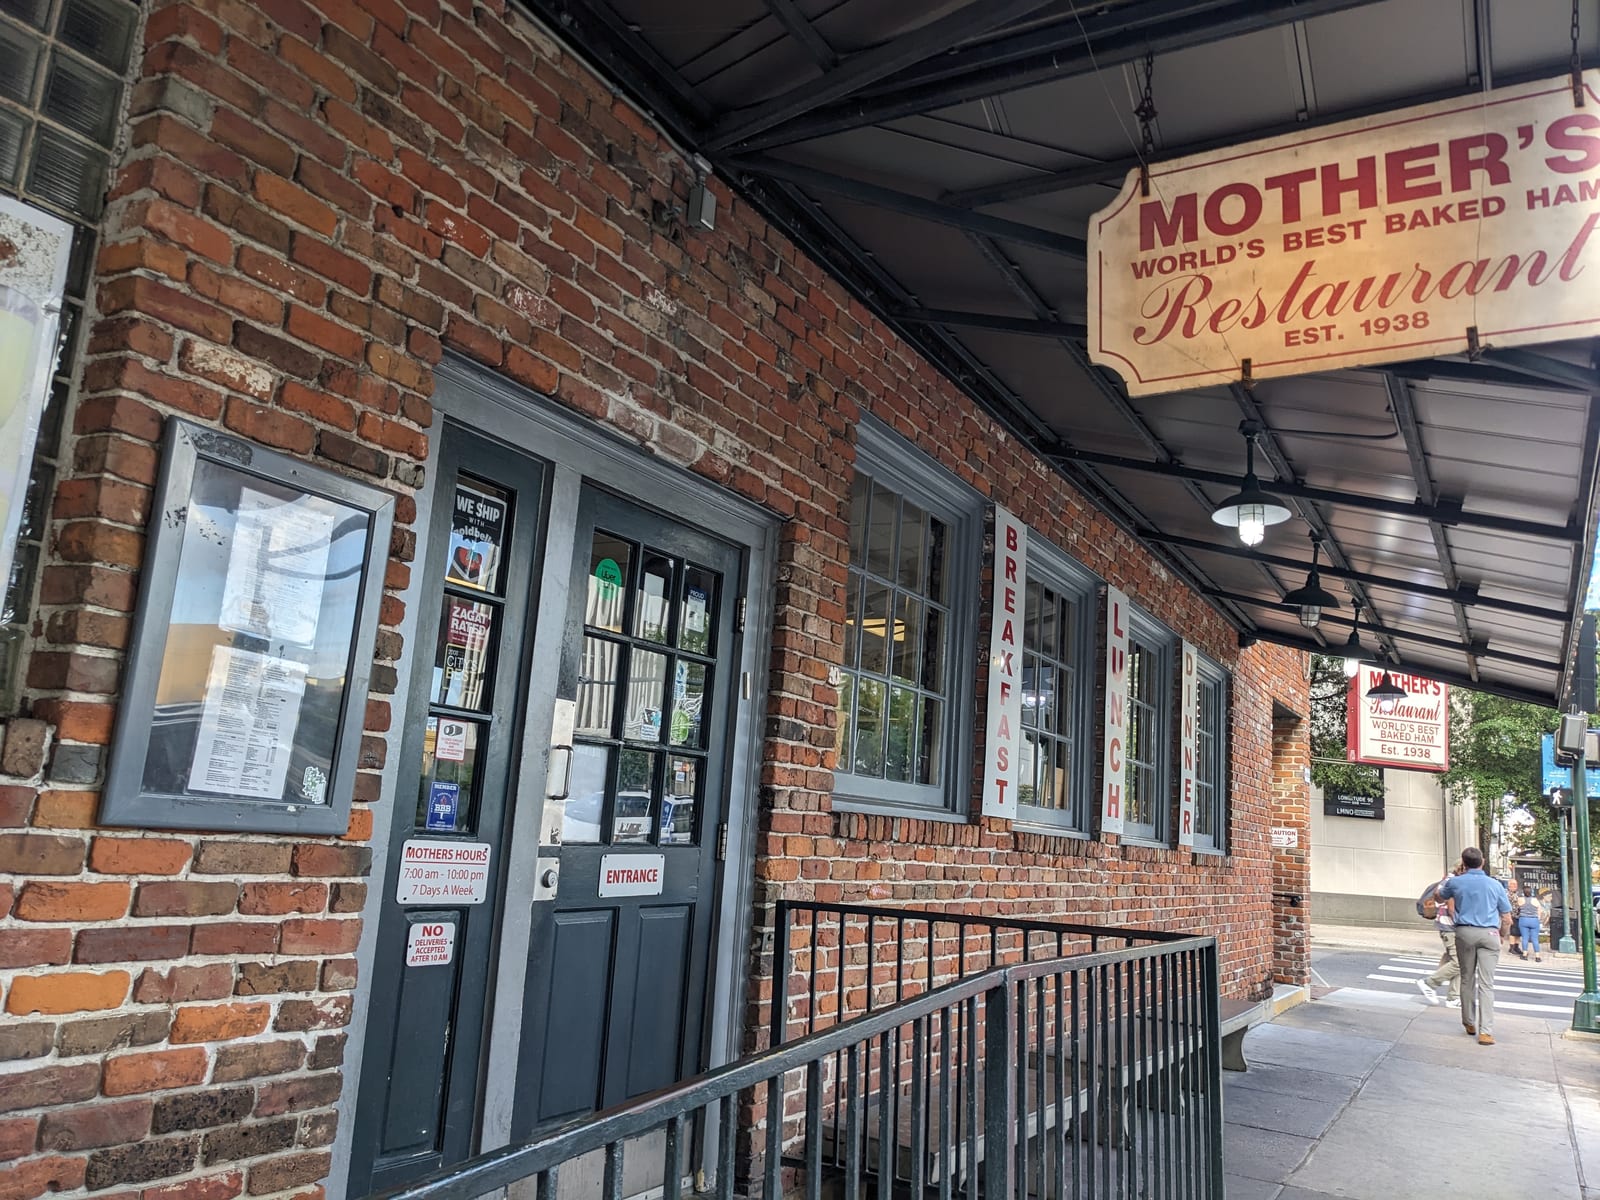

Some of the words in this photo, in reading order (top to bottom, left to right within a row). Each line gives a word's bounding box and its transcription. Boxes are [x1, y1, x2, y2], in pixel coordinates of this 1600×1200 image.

[1138, 113, 1600, 252] MOTHER'S
[1131, 238, 1266, 280] WORLD'S
[1282, 219, 1367, 253] BEST
[1385, 195, 1506, 235] BAKED
[1526, 178, 1600, 211] HAM
[1132, 210, 1600, 347] Restaurant
[1284, 324, 1345, 348] EST.
[1359, 311, 1431, 337] 1938
[456, 494, 475, 514] WE
[475, 502, 500, 522] SHIP
[469, 516, 485, 527] WITH
[452, 605, 489, 625] ZAGAT
[450, 618, 487, 637] RATED
[996, 524, 1019, 805] BREAKFAST
[445, 667, 477, 682] BEST
[1107, 602, 1124, 819] LUNCH
[1370, 697, 1441, 720] Rtaurant
[1372, 719, 1415, 733] WORLD'S
[1417, 725, 1439, 735] BEST
[1183, 652, 1194, 836] DINNER
[1380, 730, 1412, 741] BAKED
[1414, 734, 1435, 744] HAM
[1381, 744, 1400, 755] Est.
[1403, 747, 1431, 758] 1938
[405, 847, 453, 860] MOTHERS
[455, 849, 488, 862] HOURS
[403, 868, 423, 879] 7:00
[425, 870, 439, 879] am
[447, 869, 469, 880] 10:00
[470, 871, 485, 882] pm
[606, 868, 658, 884] ENTRANCE
[411, 884, 419, 895] 7
[420, 884, 441, 897] Days
[442, 884, 449, 895] A
[451, 884, 474, 896] Week
[421, 925, 444, 937] NO
[410, 954, 430, 962] AFTER
[438, 953, 448, 961] AM
[415, 946, 446, 954] ACCEPTED
